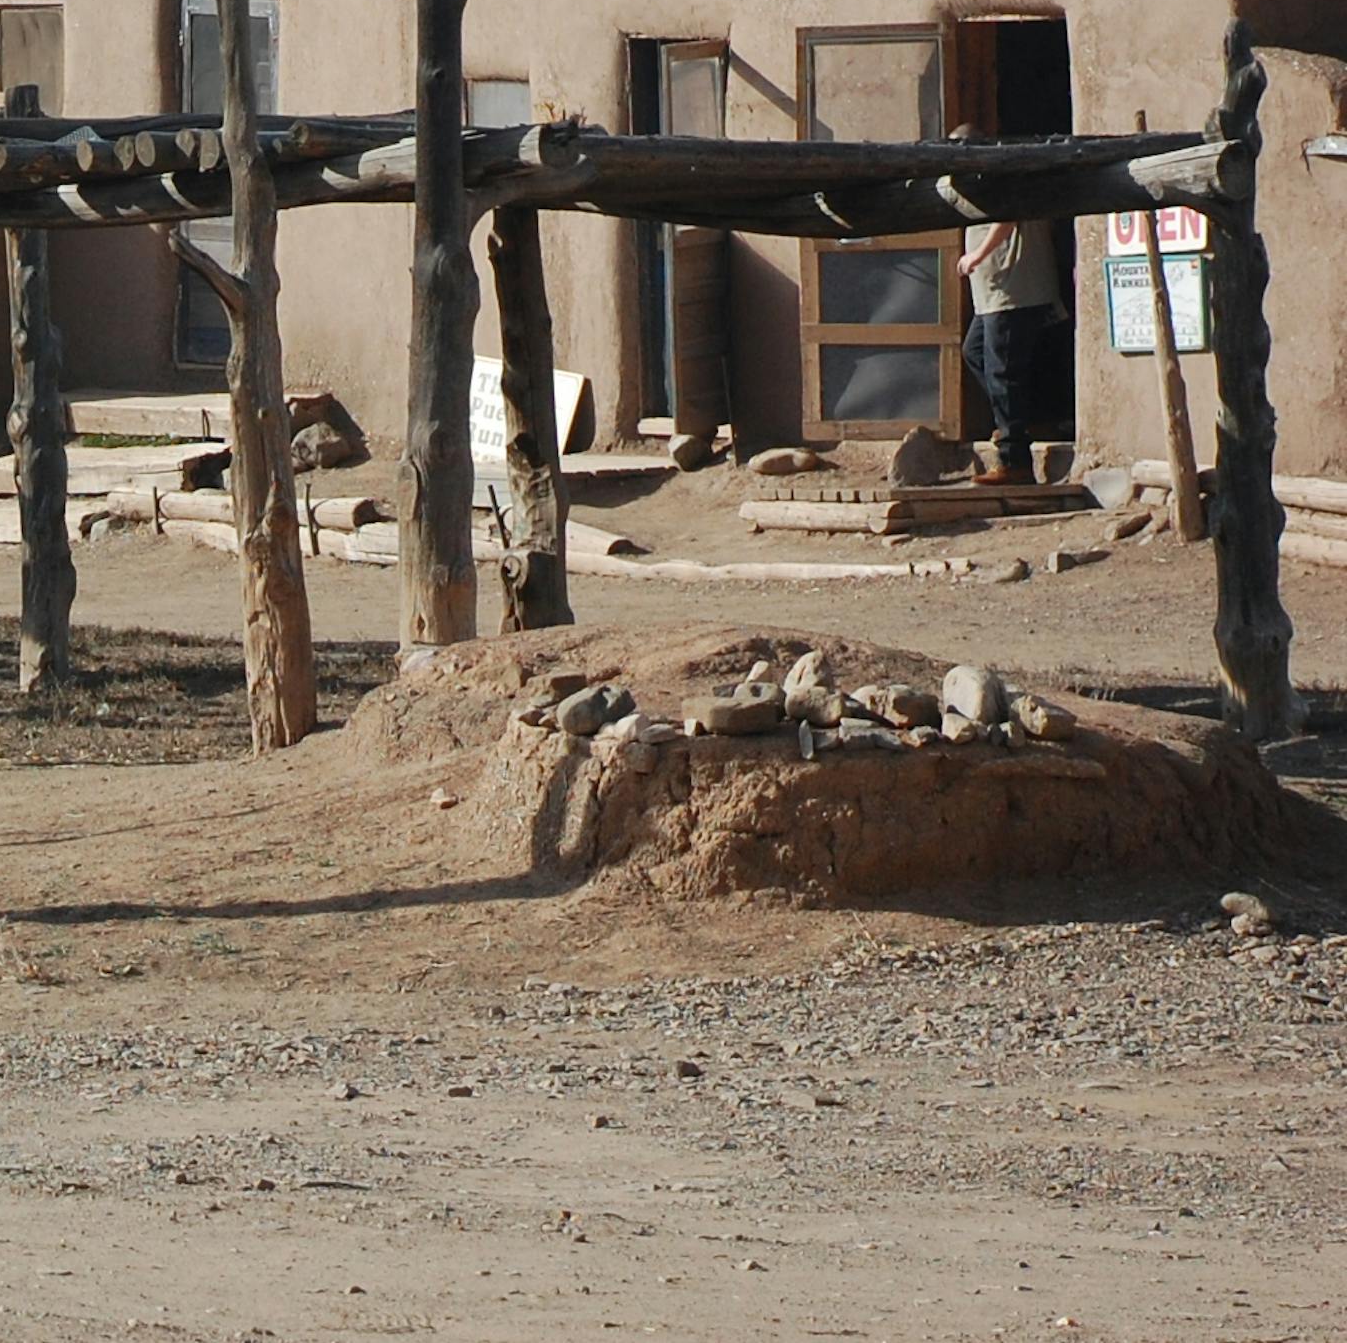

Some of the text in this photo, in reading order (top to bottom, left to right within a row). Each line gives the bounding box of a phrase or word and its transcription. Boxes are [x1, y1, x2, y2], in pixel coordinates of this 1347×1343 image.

[1114, 207, 1200, 245] OEN
[478, 372, 501, 394] Th
[470, 396, 504, 421] Pue
